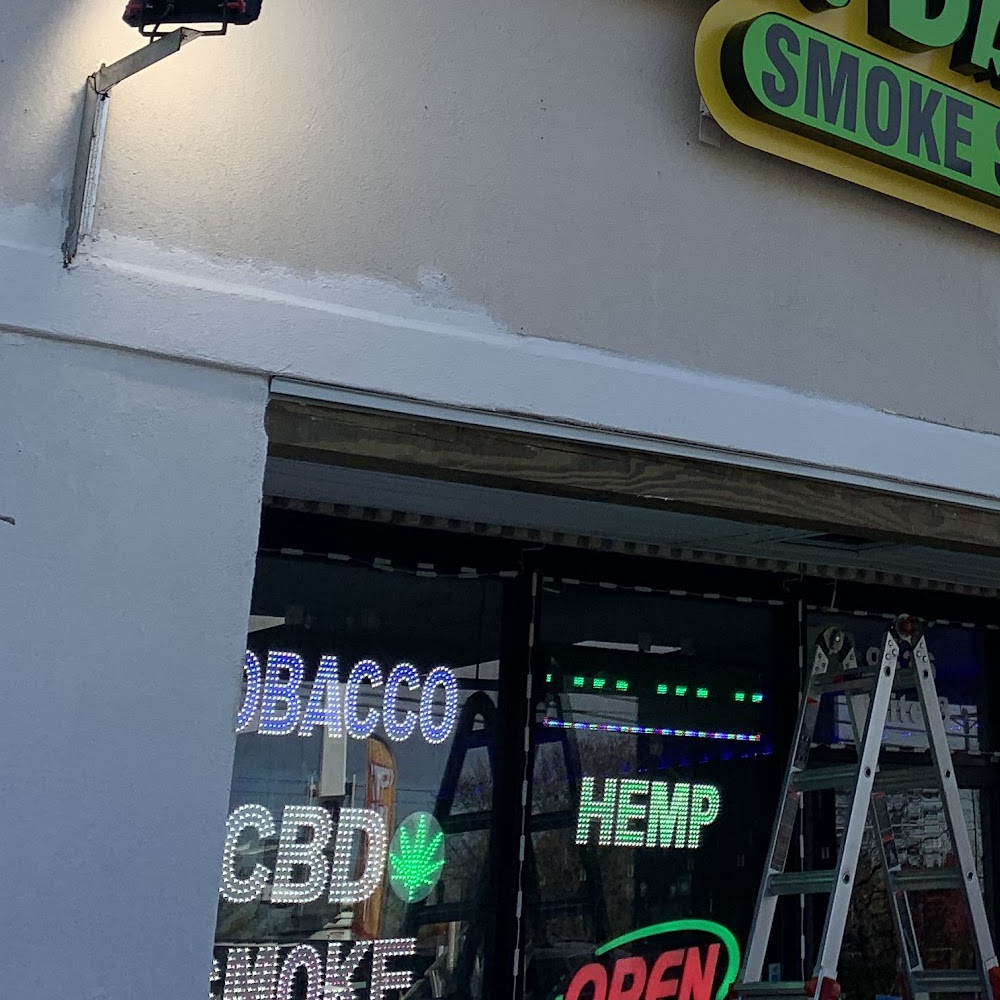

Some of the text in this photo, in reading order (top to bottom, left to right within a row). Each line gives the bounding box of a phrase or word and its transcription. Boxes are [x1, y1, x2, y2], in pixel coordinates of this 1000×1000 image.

[761, 22, 975, 178] SMOKE
[575, 776, 720, 848] HEMP
[219, 804, 389, 904] CBD
[209, 938, 417, 1000] MOKE
[563, 943, 721, 1000] OPEN
